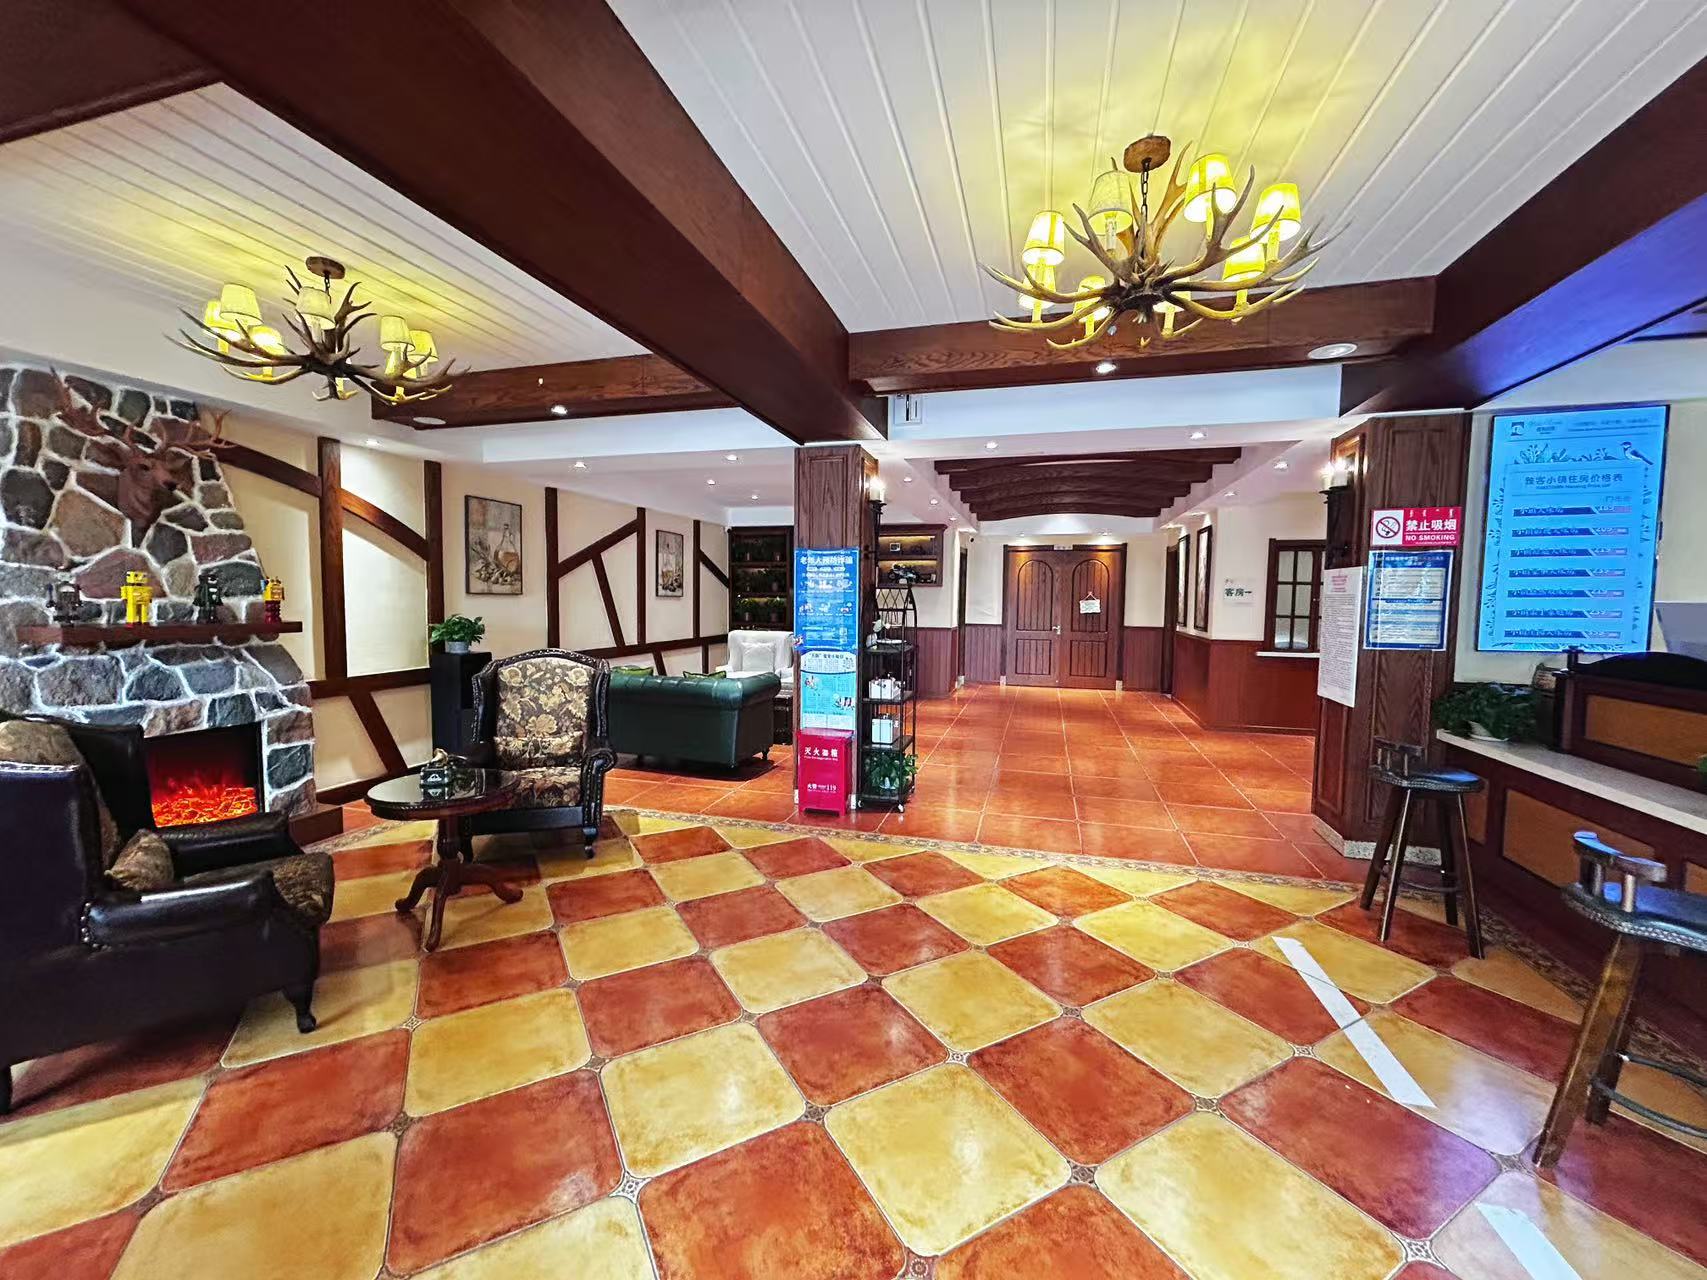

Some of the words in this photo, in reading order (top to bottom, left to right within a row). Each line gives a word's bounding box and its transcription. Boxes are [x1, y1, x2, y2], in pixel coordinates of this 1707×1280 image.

[1405, 519, 1457, 531] 禁止吸烟
[804, 746, 838, 758] 灭火器箱
